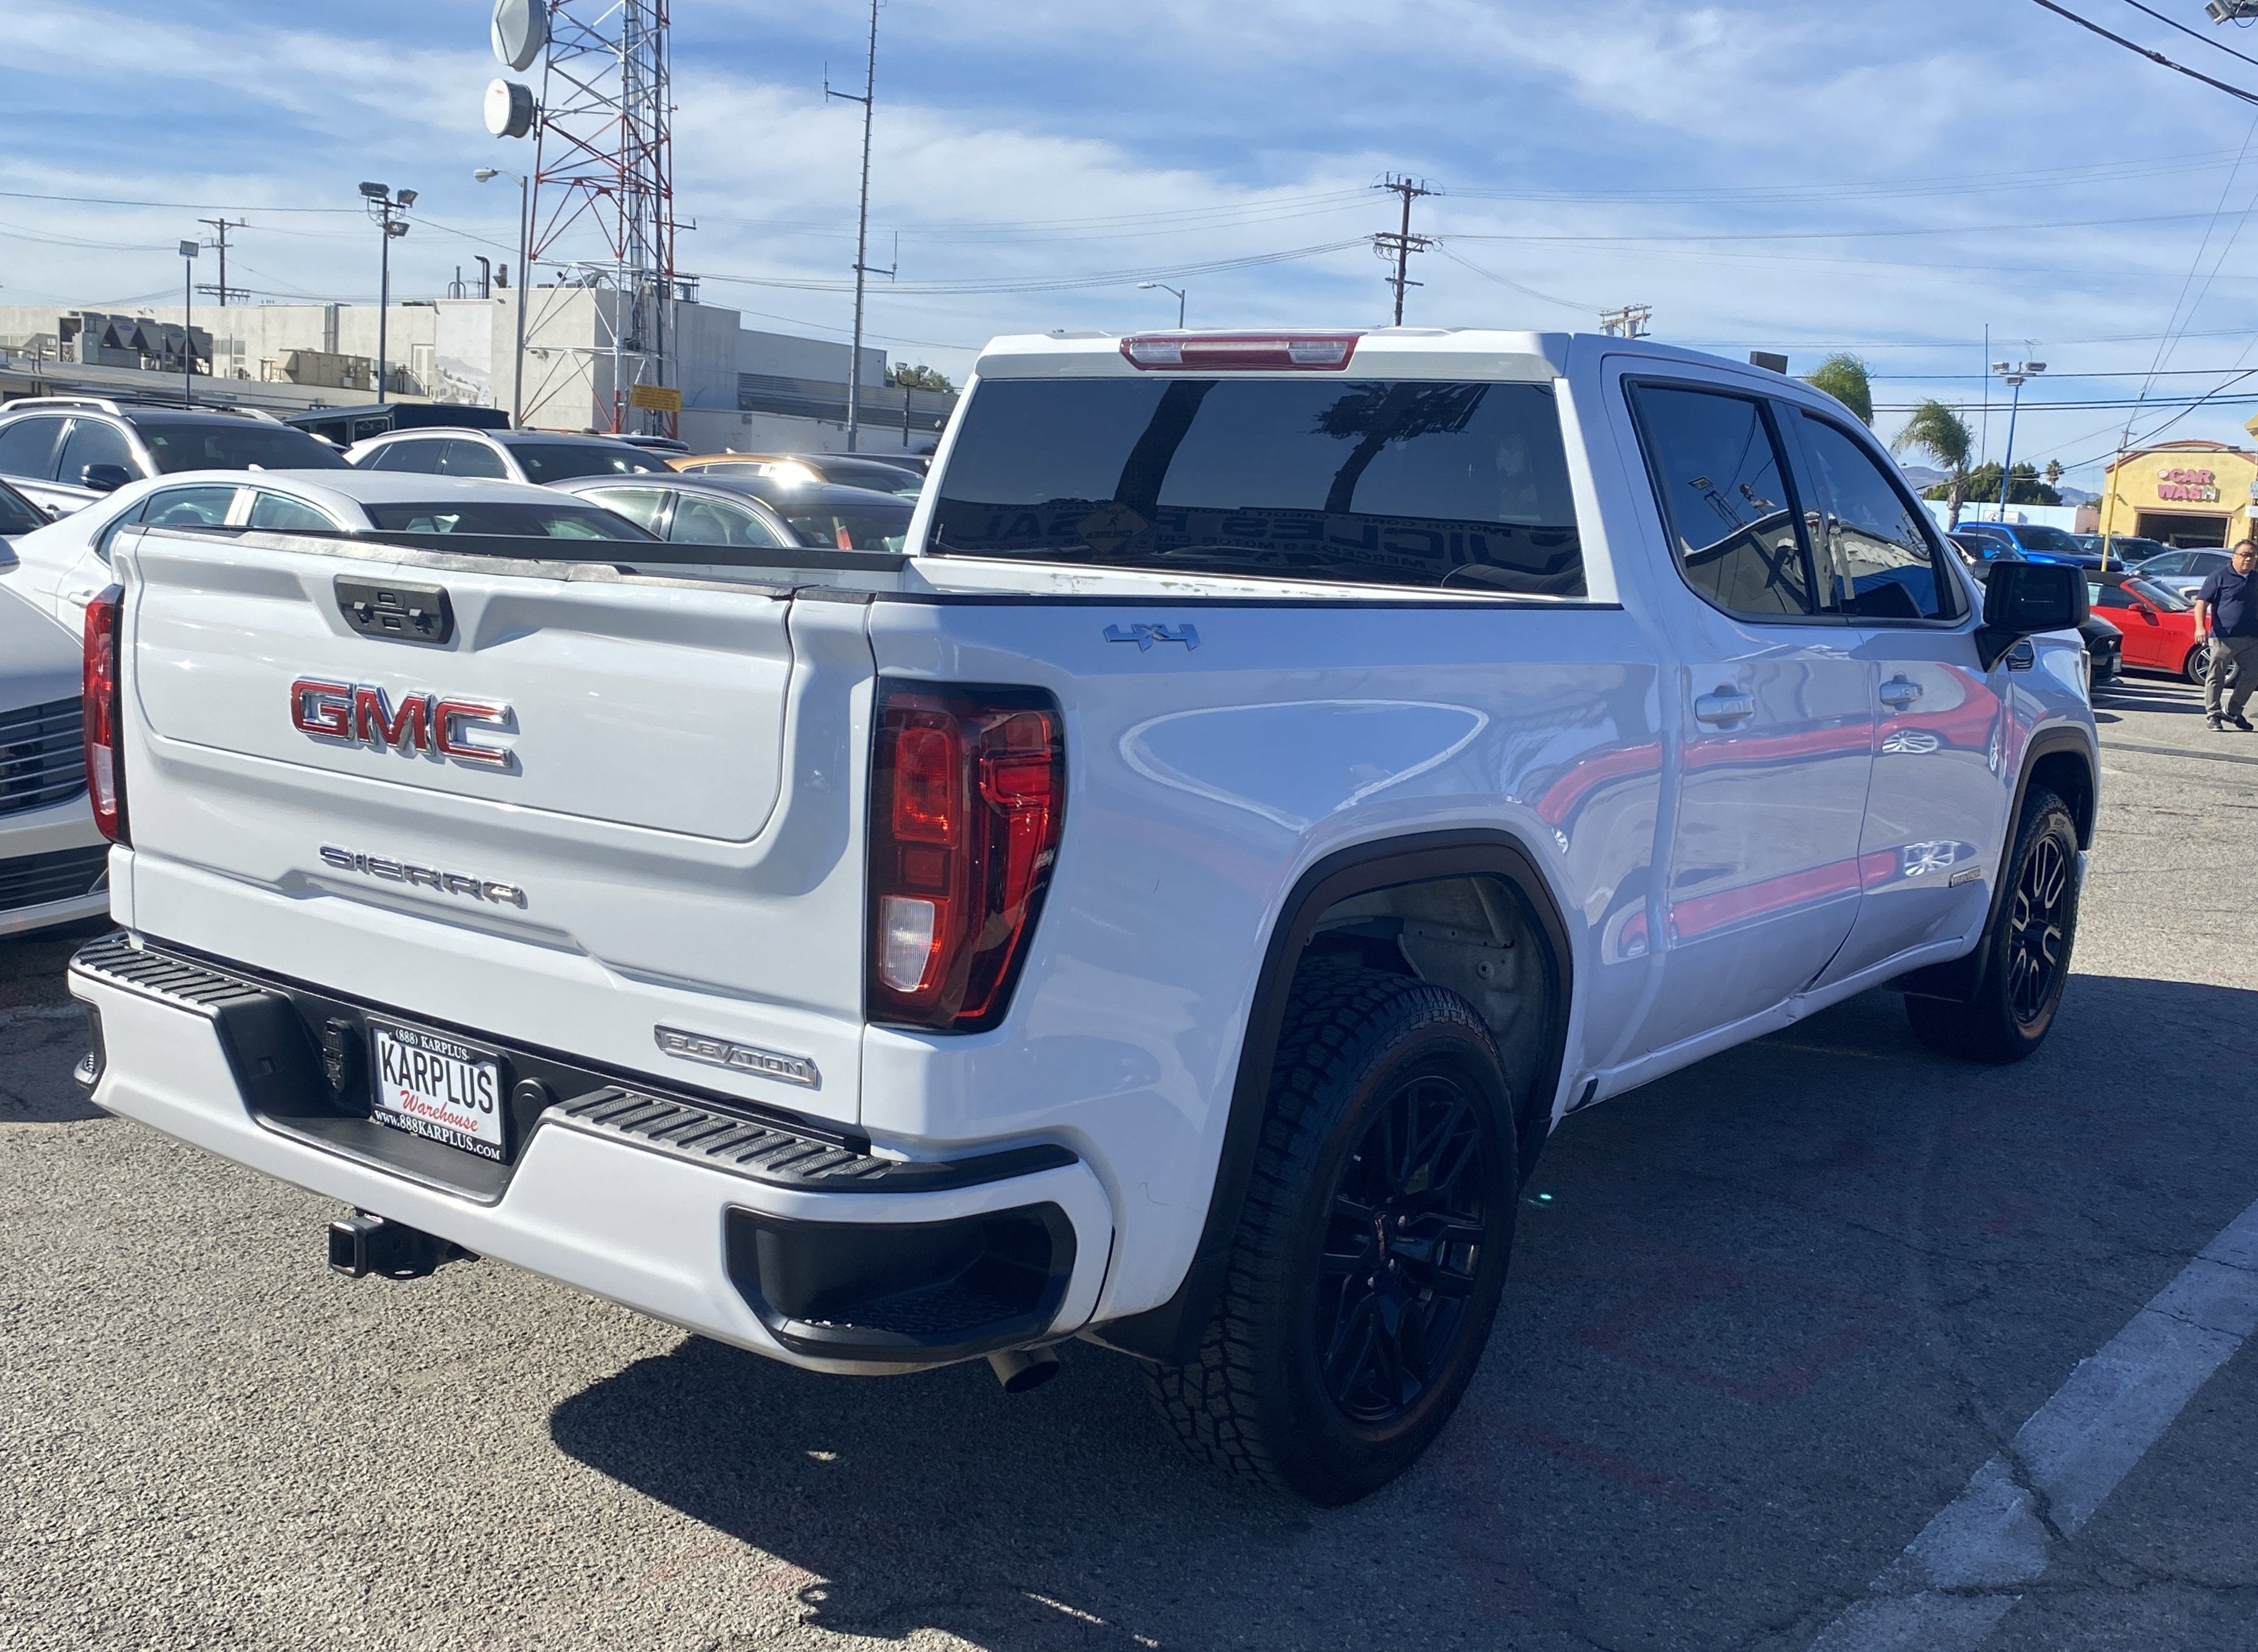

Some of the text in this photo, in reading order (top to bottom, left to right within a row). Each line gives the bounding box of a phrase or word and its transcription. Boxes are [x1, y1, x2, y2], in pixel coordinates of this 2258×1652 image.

[2158, 484, 2218, 502] WASH
[2169, 469, 2213, 484] CAR
[290, 675, 512, 768] GMC
[319, 845, 523, 906] SIERRA
[395, 1028, 418, 1045] (888)
[666, 1033, 804, 1076] ELEVATION
[380, 1039, 493, 1115] KARPLUS
[399, 1089, 479, 1132] Warehouse
